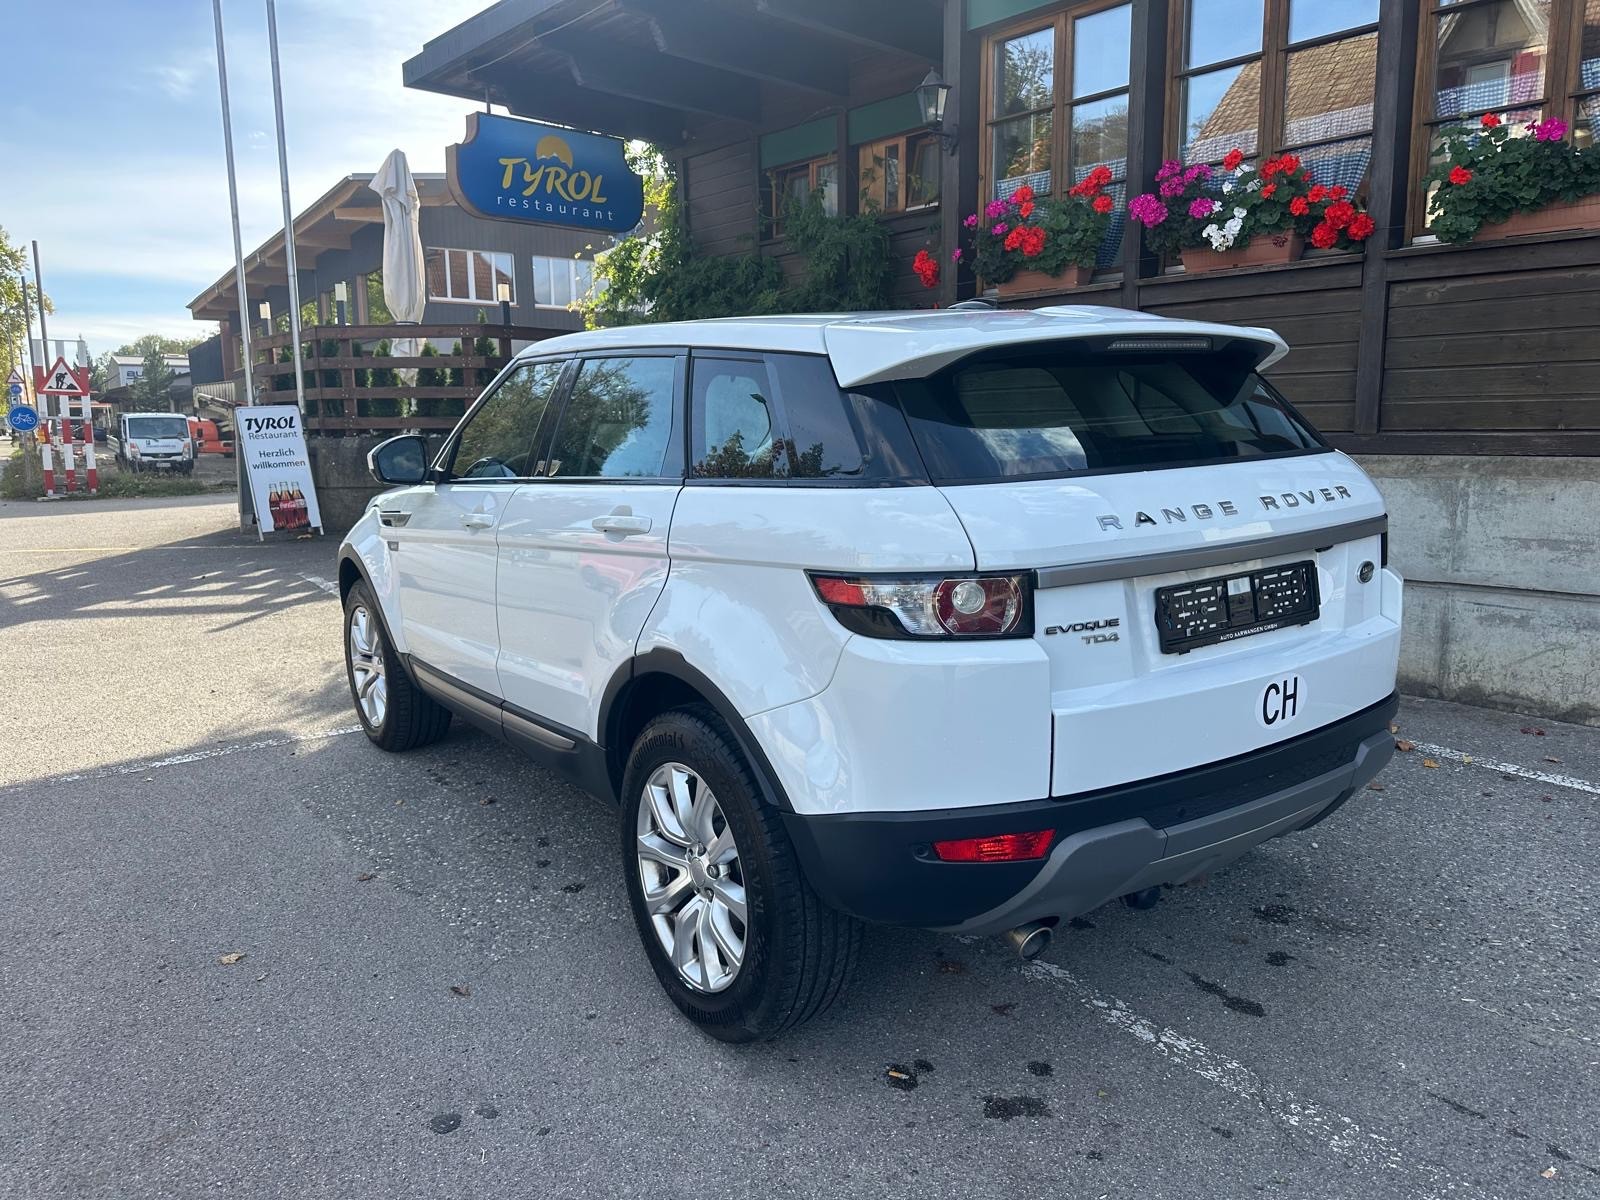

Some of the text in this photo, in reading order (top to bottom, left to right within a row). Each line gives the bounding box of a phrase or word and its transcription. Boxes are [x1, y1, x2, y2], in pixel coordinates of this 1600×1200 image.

[498, 157, 607, 203] TYROL
[497, 196, 613, 221] restaurant
[245, 416, 296, 433] TYROL
[249, 431, 298, 440] Restaurant
[258, 448, 295, 458] Herzlich
[252, 460, 306, 470] willkommen
[1096, 485, 1352, 531] RANGE ROVER
[1045, 618, 1120, 635] EVOQUE
[1081, 632, 1120, 644] TD4
[1262, 676, 1299, 725] CH
